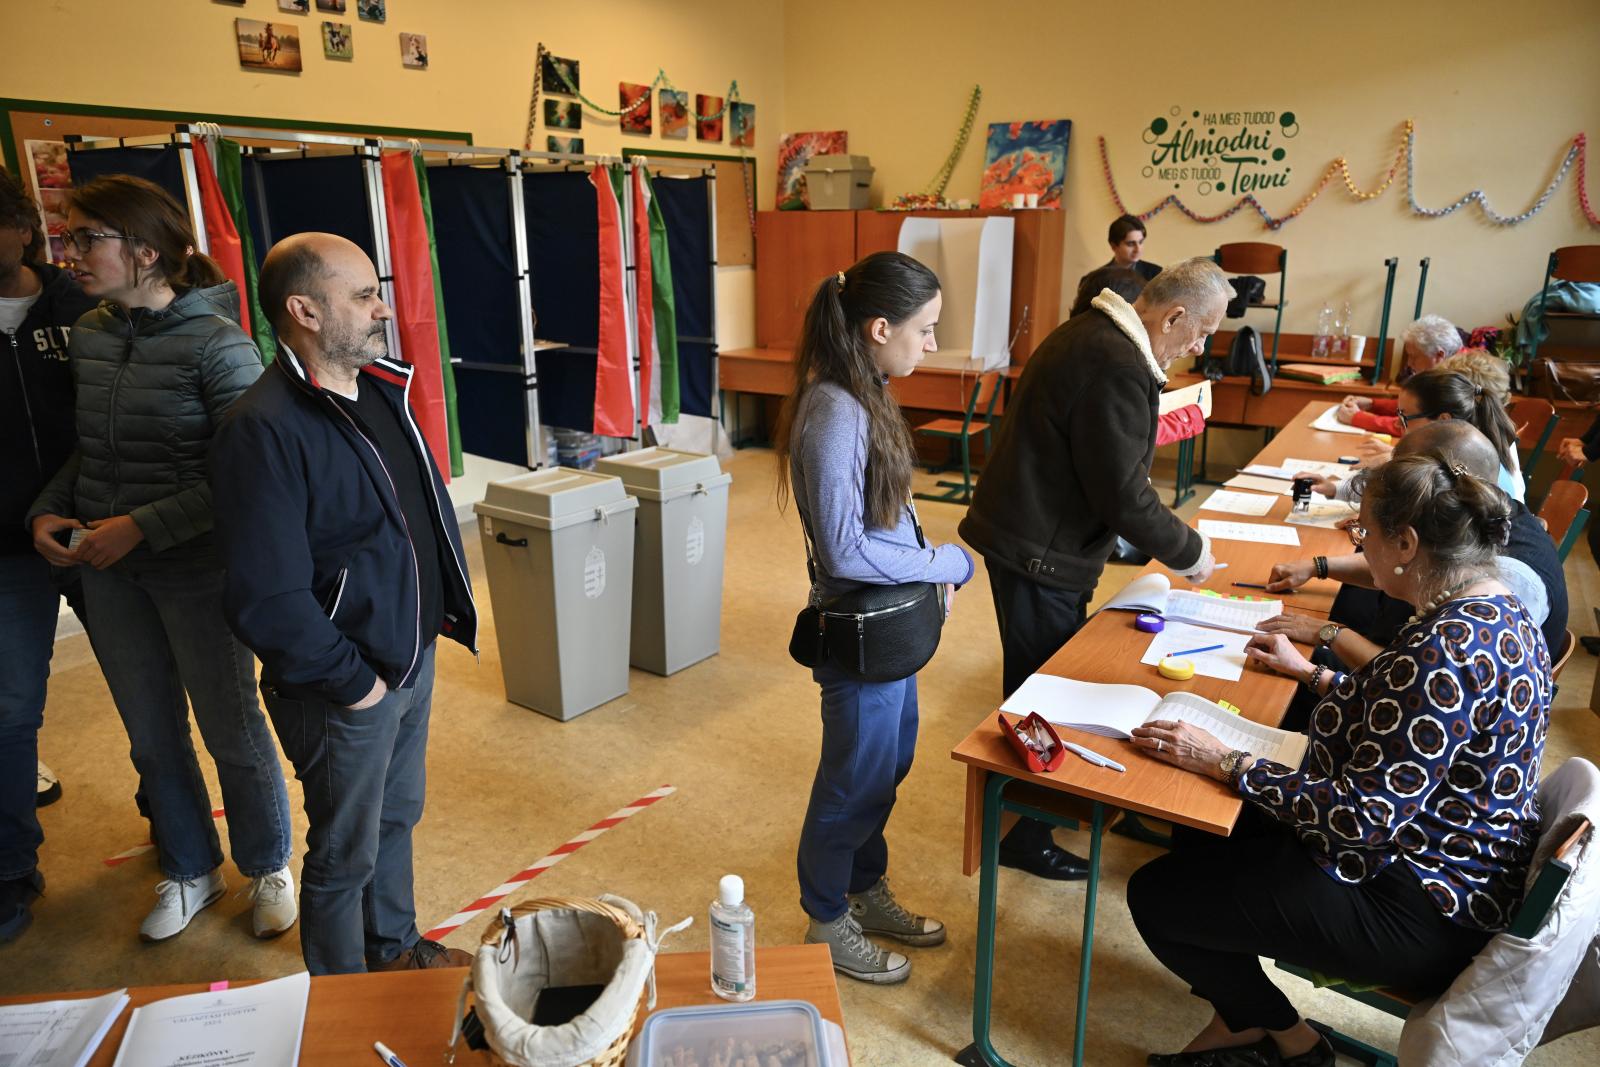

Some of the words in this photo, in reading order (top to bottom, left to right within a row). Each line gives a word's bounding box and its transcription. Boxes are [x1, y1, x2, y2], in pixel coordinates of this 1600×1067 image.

[1203, 113, 1217, 126] HA
[1219, 112, 1240, 125] MEG
[1243, 111, 1275, 125] TUDOD
[1151, 120, 1272, 166] Álmodni
[1158, 168, 1177, 180] MEG
[1179, 168, 1189, 180] IS
[1191, 167, 1221, 180] TUDOD
[1220, 153, 1291, 195] Tenni
